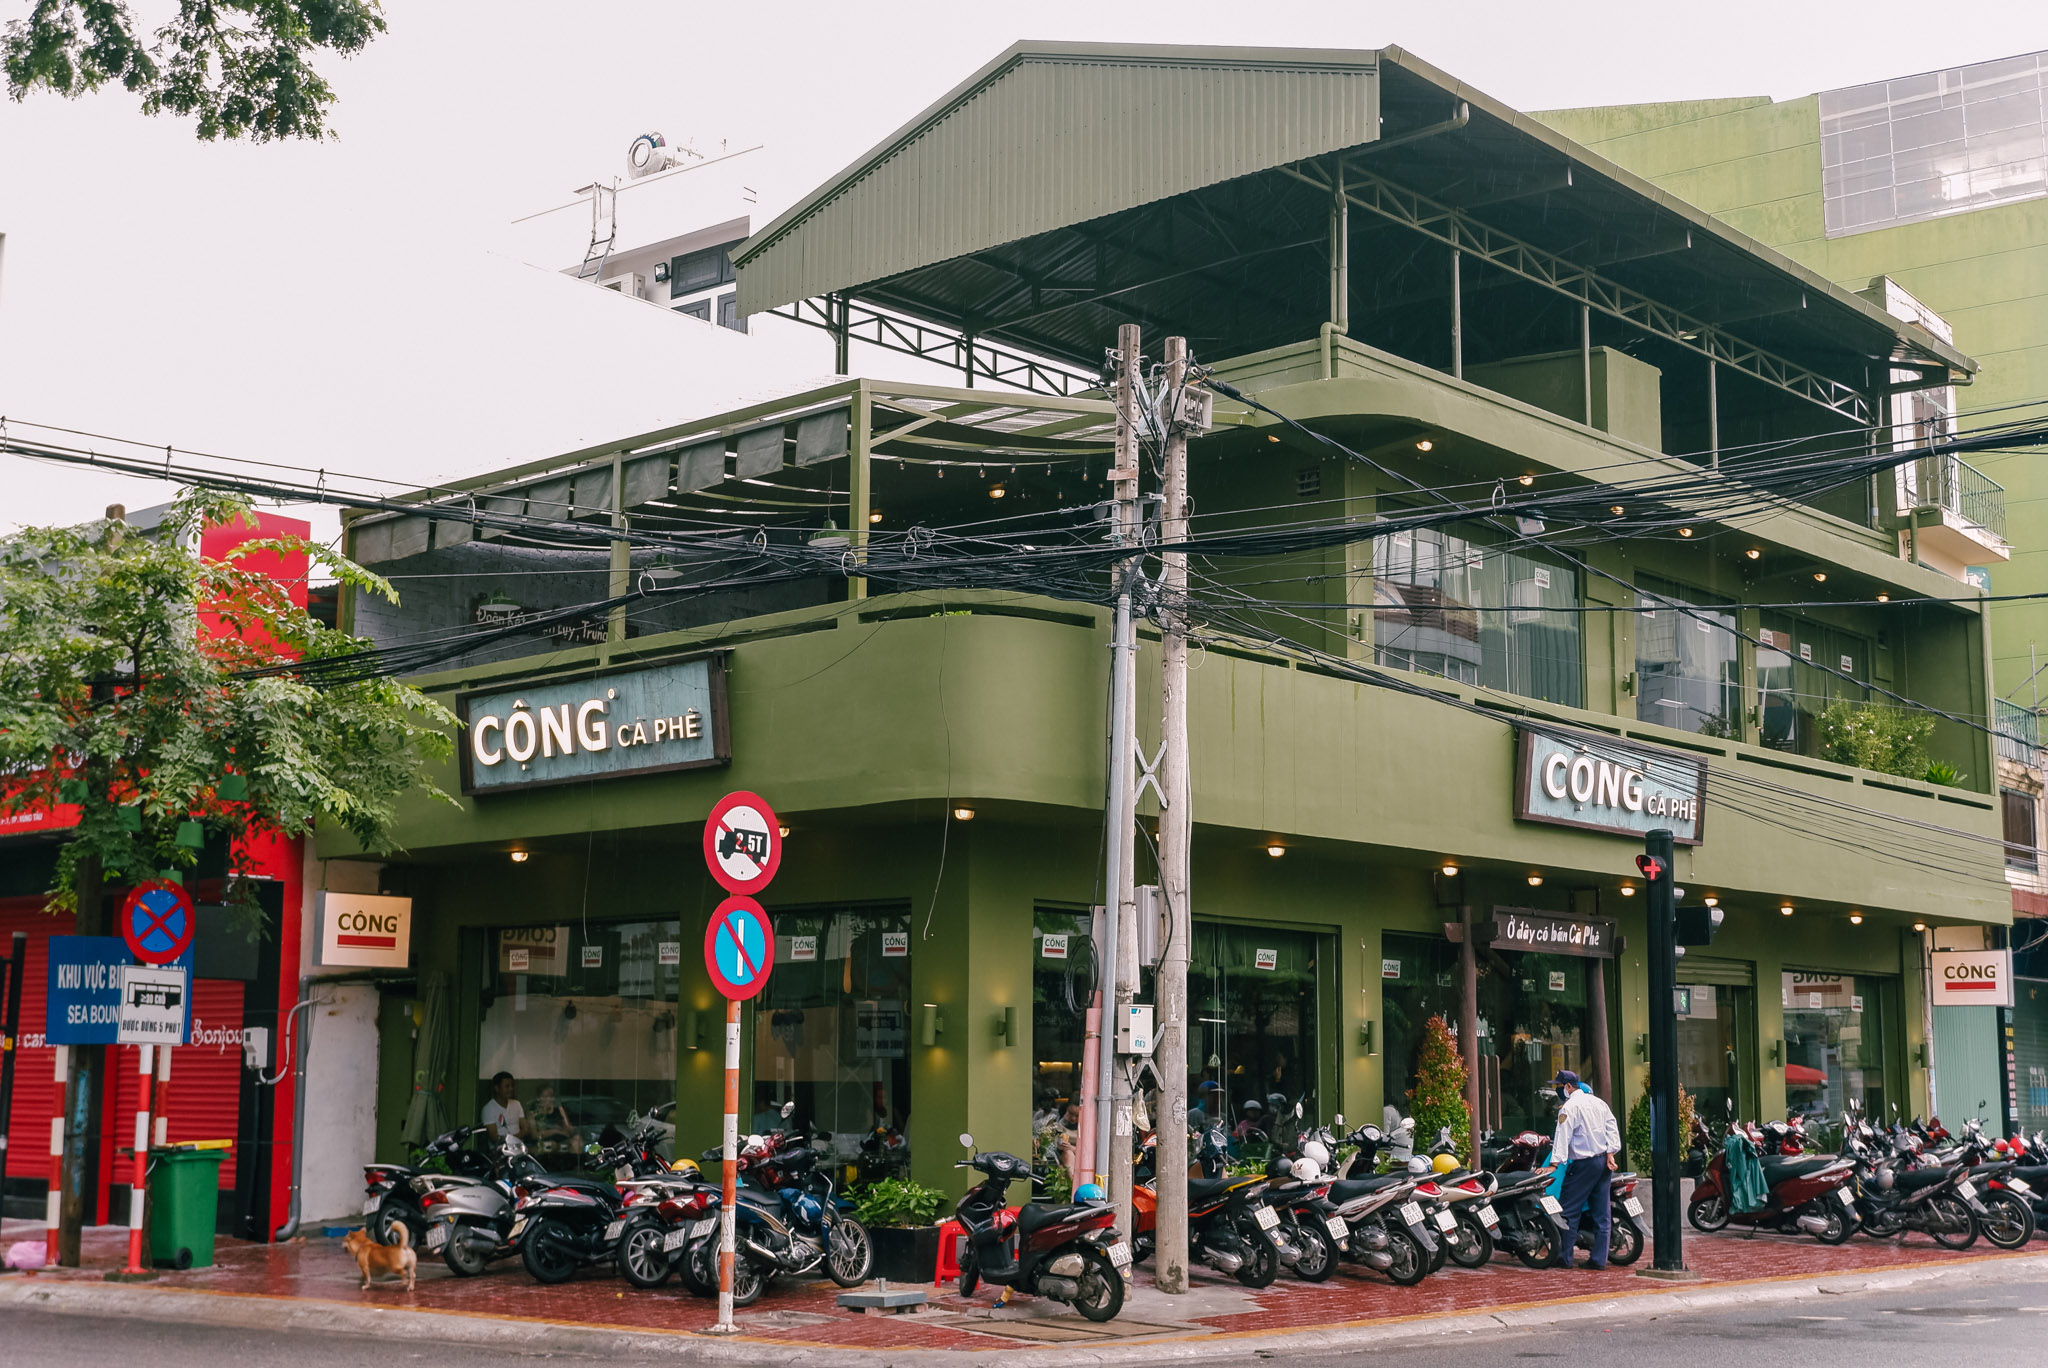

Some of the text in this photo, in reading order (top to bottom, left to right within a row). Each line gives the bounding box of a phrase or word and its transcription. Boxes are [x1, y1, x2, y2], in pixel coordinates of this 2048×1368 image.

[473, 698, 610, 772] CỘNG
[654, 706, 700, 743] PHÊ
[1543, 744, 1644, 813] CỘNG
[1670, 796, 1697, 822] PHÊ
[735, 832, 763, 854] 2,5T
[337, 909, 398, 935] CỘNG
[1516, 920, 1536, 944] đây
[1536, 926, 1549, 942] có
[1550, 922, 1568, 942] bán
[1568, 924, 1581, 944] Cà
[1582, 926, 1600, 946] Phê
[58, 964, 81, 989] KHU
[84, 960, 106, 994] VỰC
[1944, 962, 1996, 981] CỘNG
[67, 1004, 120, 1025] SEA BOUN
